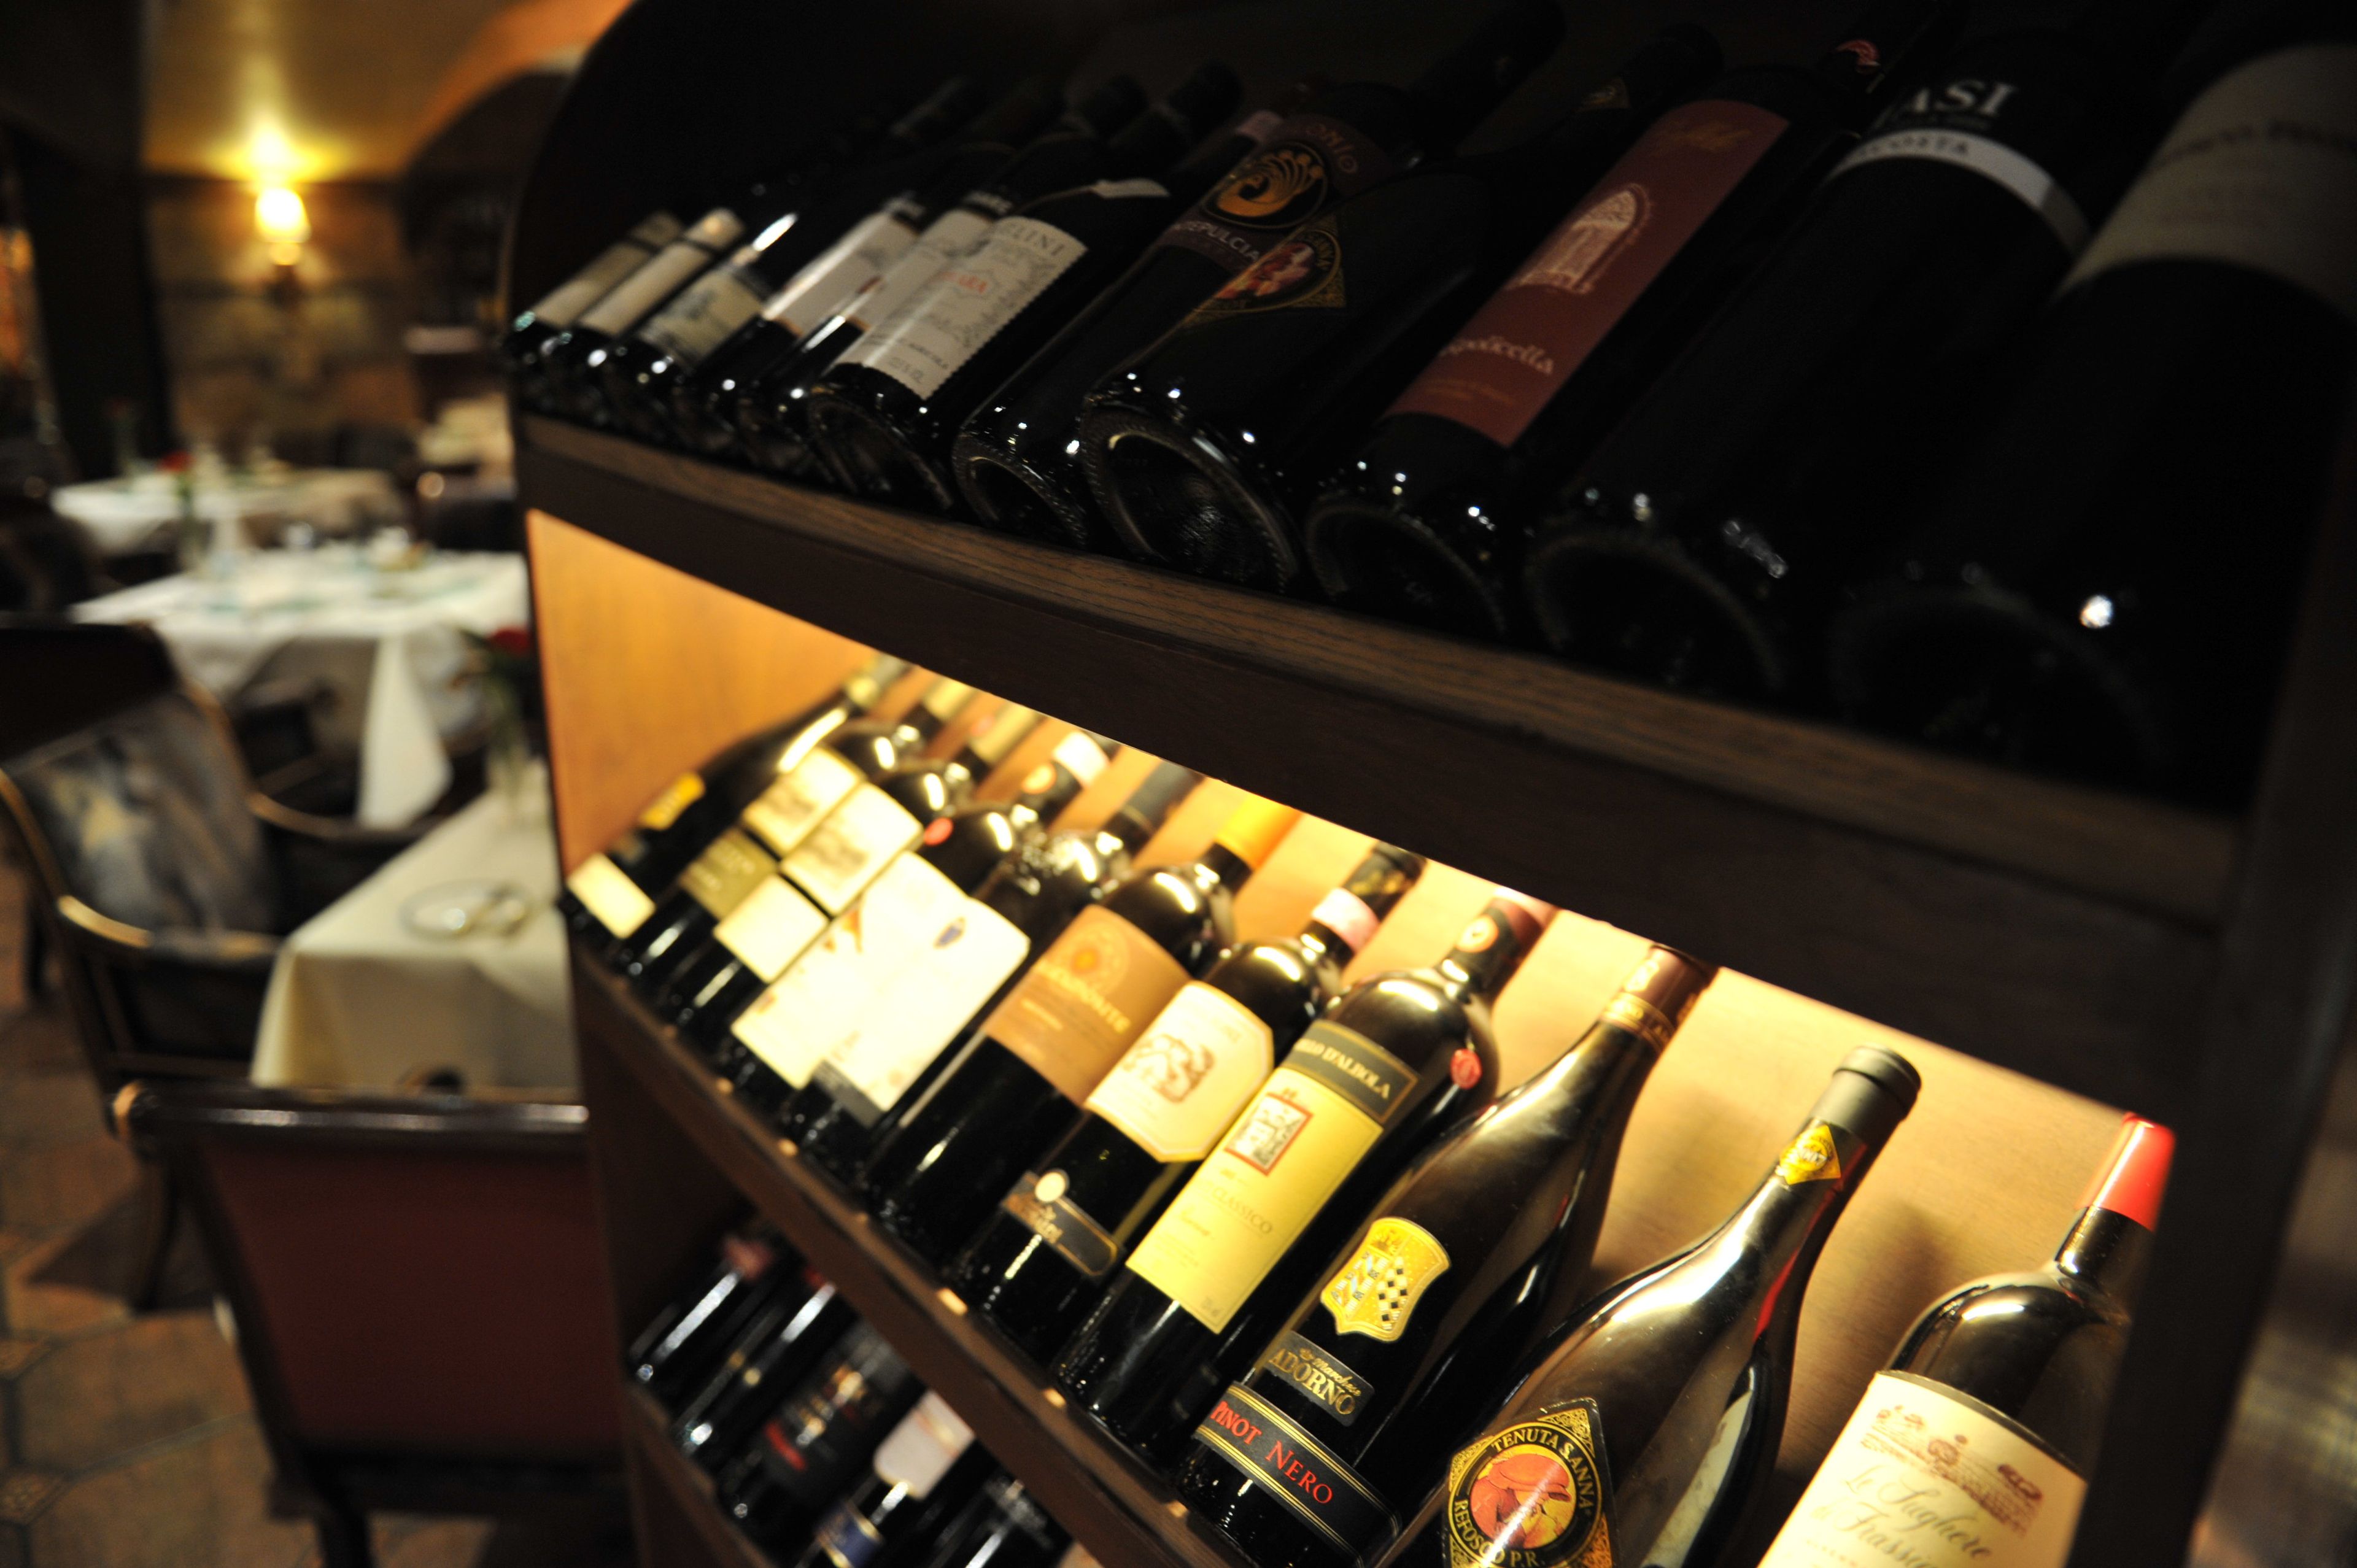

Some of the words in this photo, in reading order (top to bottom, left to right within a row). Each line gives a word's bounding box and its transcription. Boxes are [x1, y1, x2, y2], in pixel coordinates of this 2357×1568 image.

[1212, 1186, 1273, 1234] CLASSICO
[1268, 1348, 1357, 1415] ADORNO
[1209, 1399, 1262, 1446] PINOT
[1265, 1440, 1333, 1504] NERO
[1490, 1427, 1560, 1454] TENUTA
[1568, 1455, 1595, 1510] ANNA
[1453, 1499, 1506, 1564] REFOSCO
